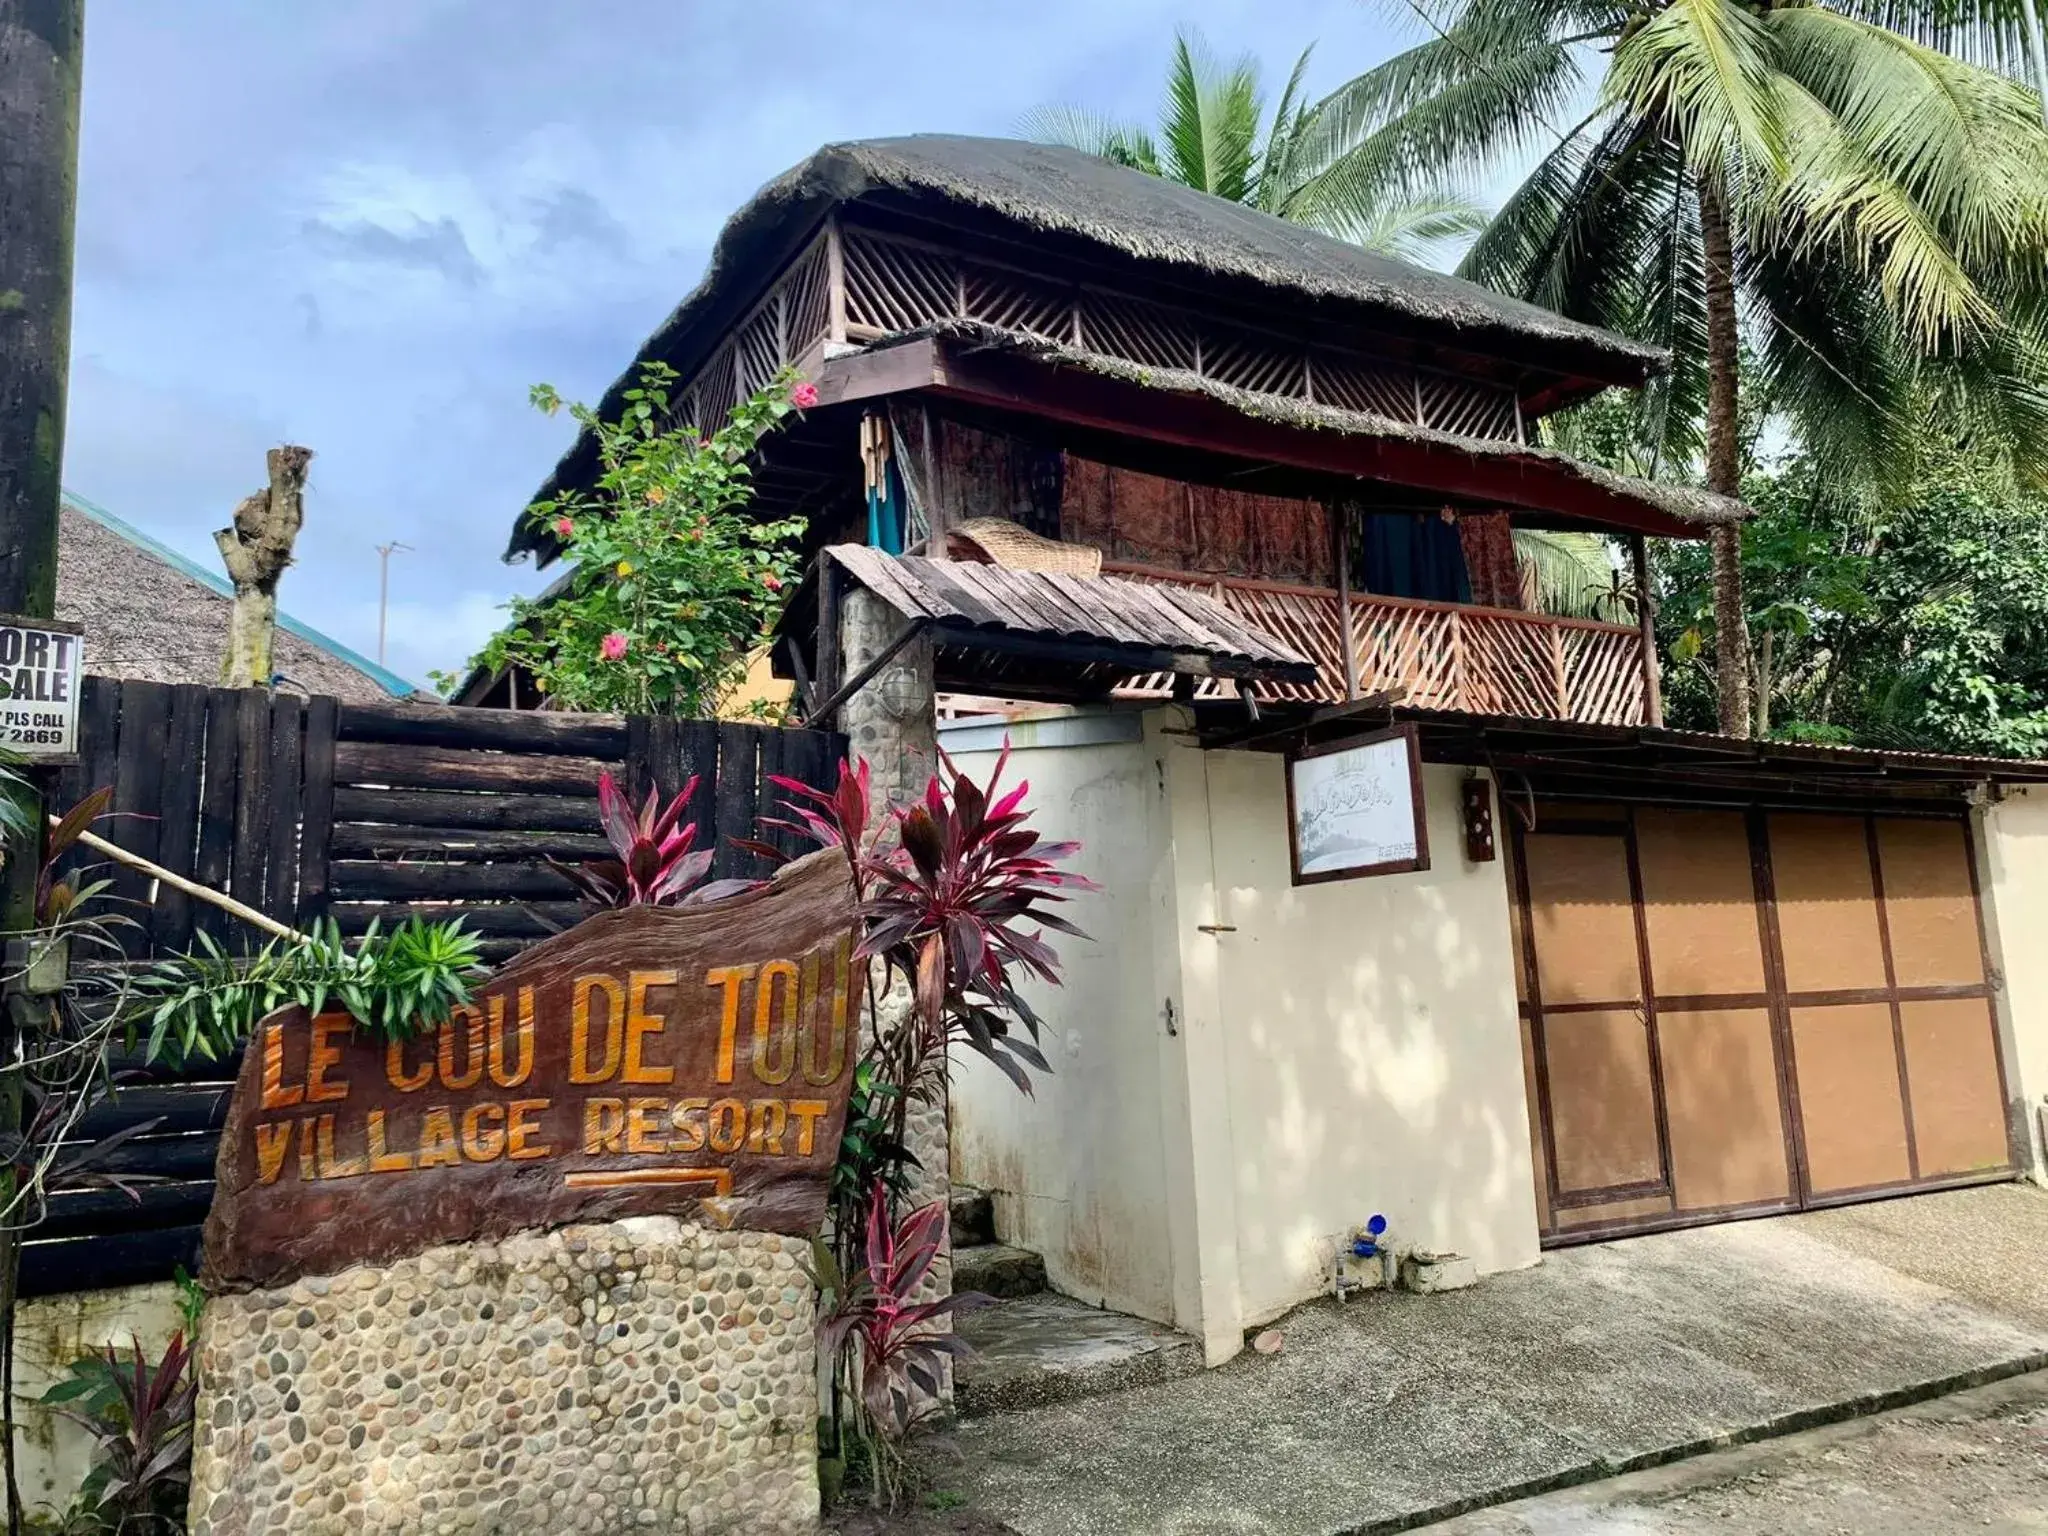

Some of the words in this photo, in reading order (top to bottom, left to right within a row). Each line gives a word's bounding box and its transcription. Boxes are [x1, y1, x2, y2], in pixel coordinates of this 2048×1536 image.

[0, 628, 74, 669] ORT
[5, 711, 30, 727] PLS
[33, 712, 65, 728] CALL
[10, 728, 63, 744] 2869
[260, 1011, 352, 1112] LE
[385, 985, 536, 1093] COU
[568, 970, 679, 1085] DE
[707, 927, 852, 1087] TOU
[255, 1098, 552, 1186] VILLAGE
[583, 1096, 829, 1158] RESORT
